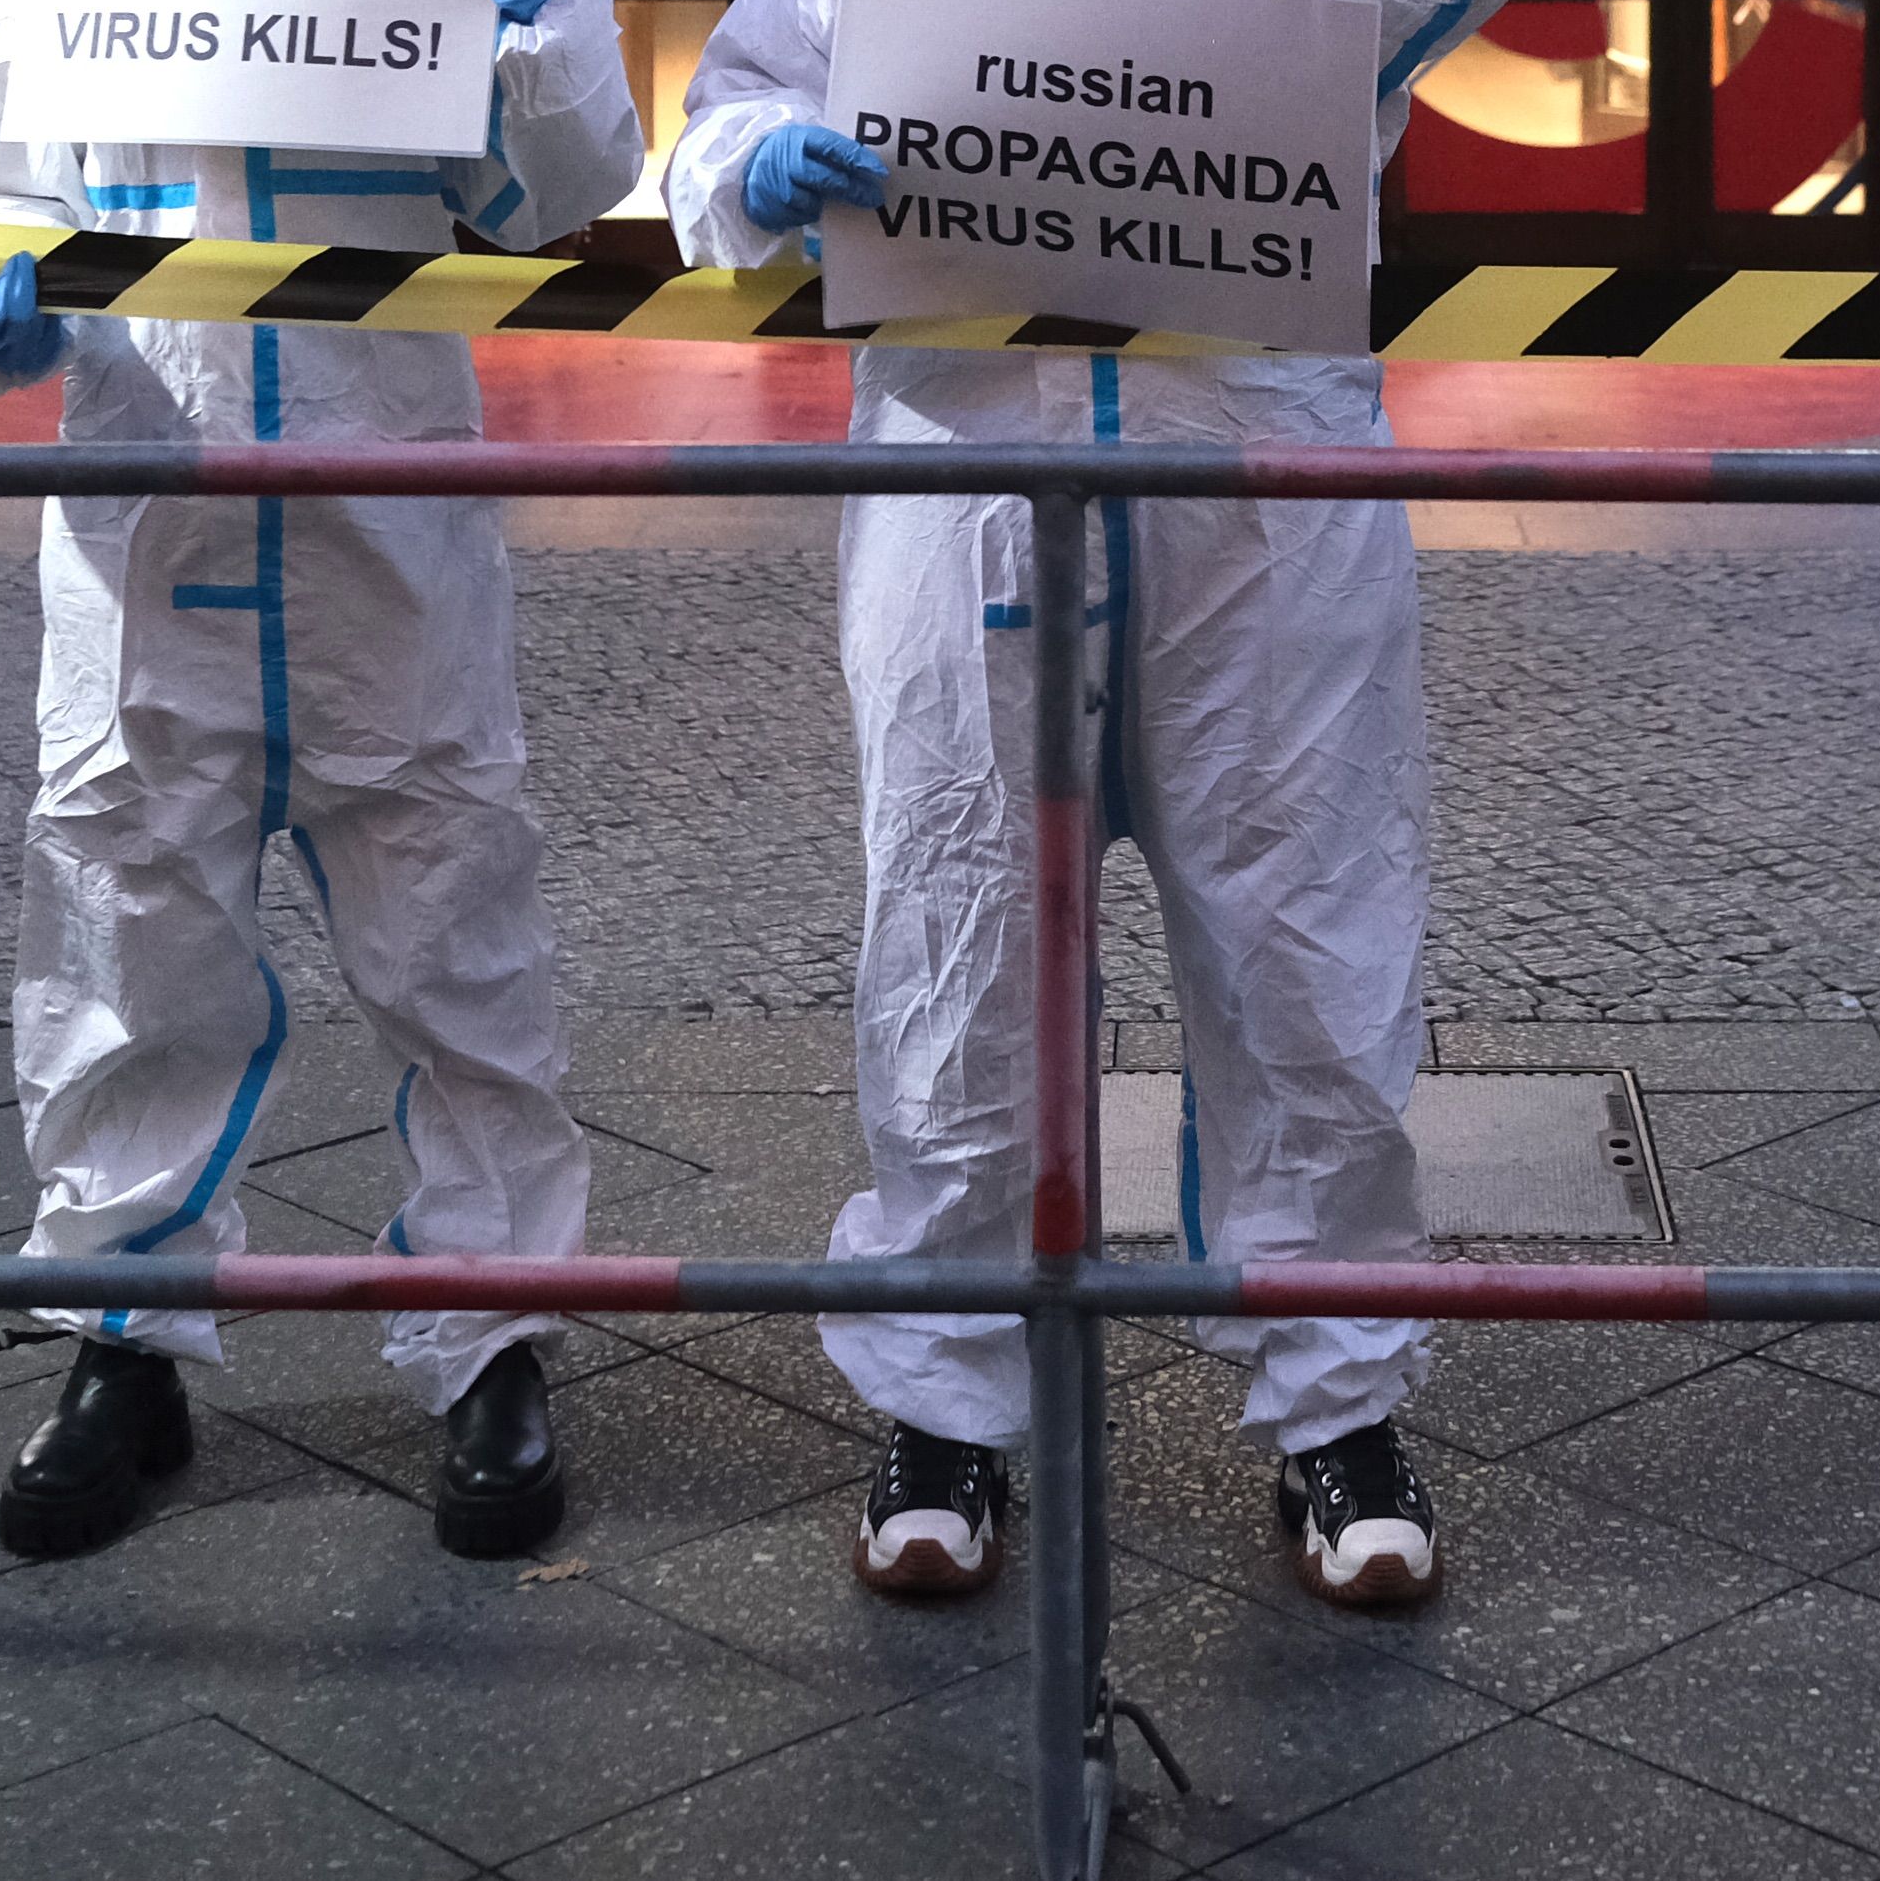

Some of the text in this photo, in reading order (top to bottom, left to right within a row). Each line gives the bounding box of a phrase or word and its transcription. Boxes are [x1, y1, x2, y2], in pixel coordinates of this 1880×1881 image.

[56, 10, 443, 71] VIRUS KILLS!
[975, 53, 1215, 119] russian
[855, 111, 1340, 211] PROPAGANDA
[875, 194, 1314, 282] VIRUS KILLS!
